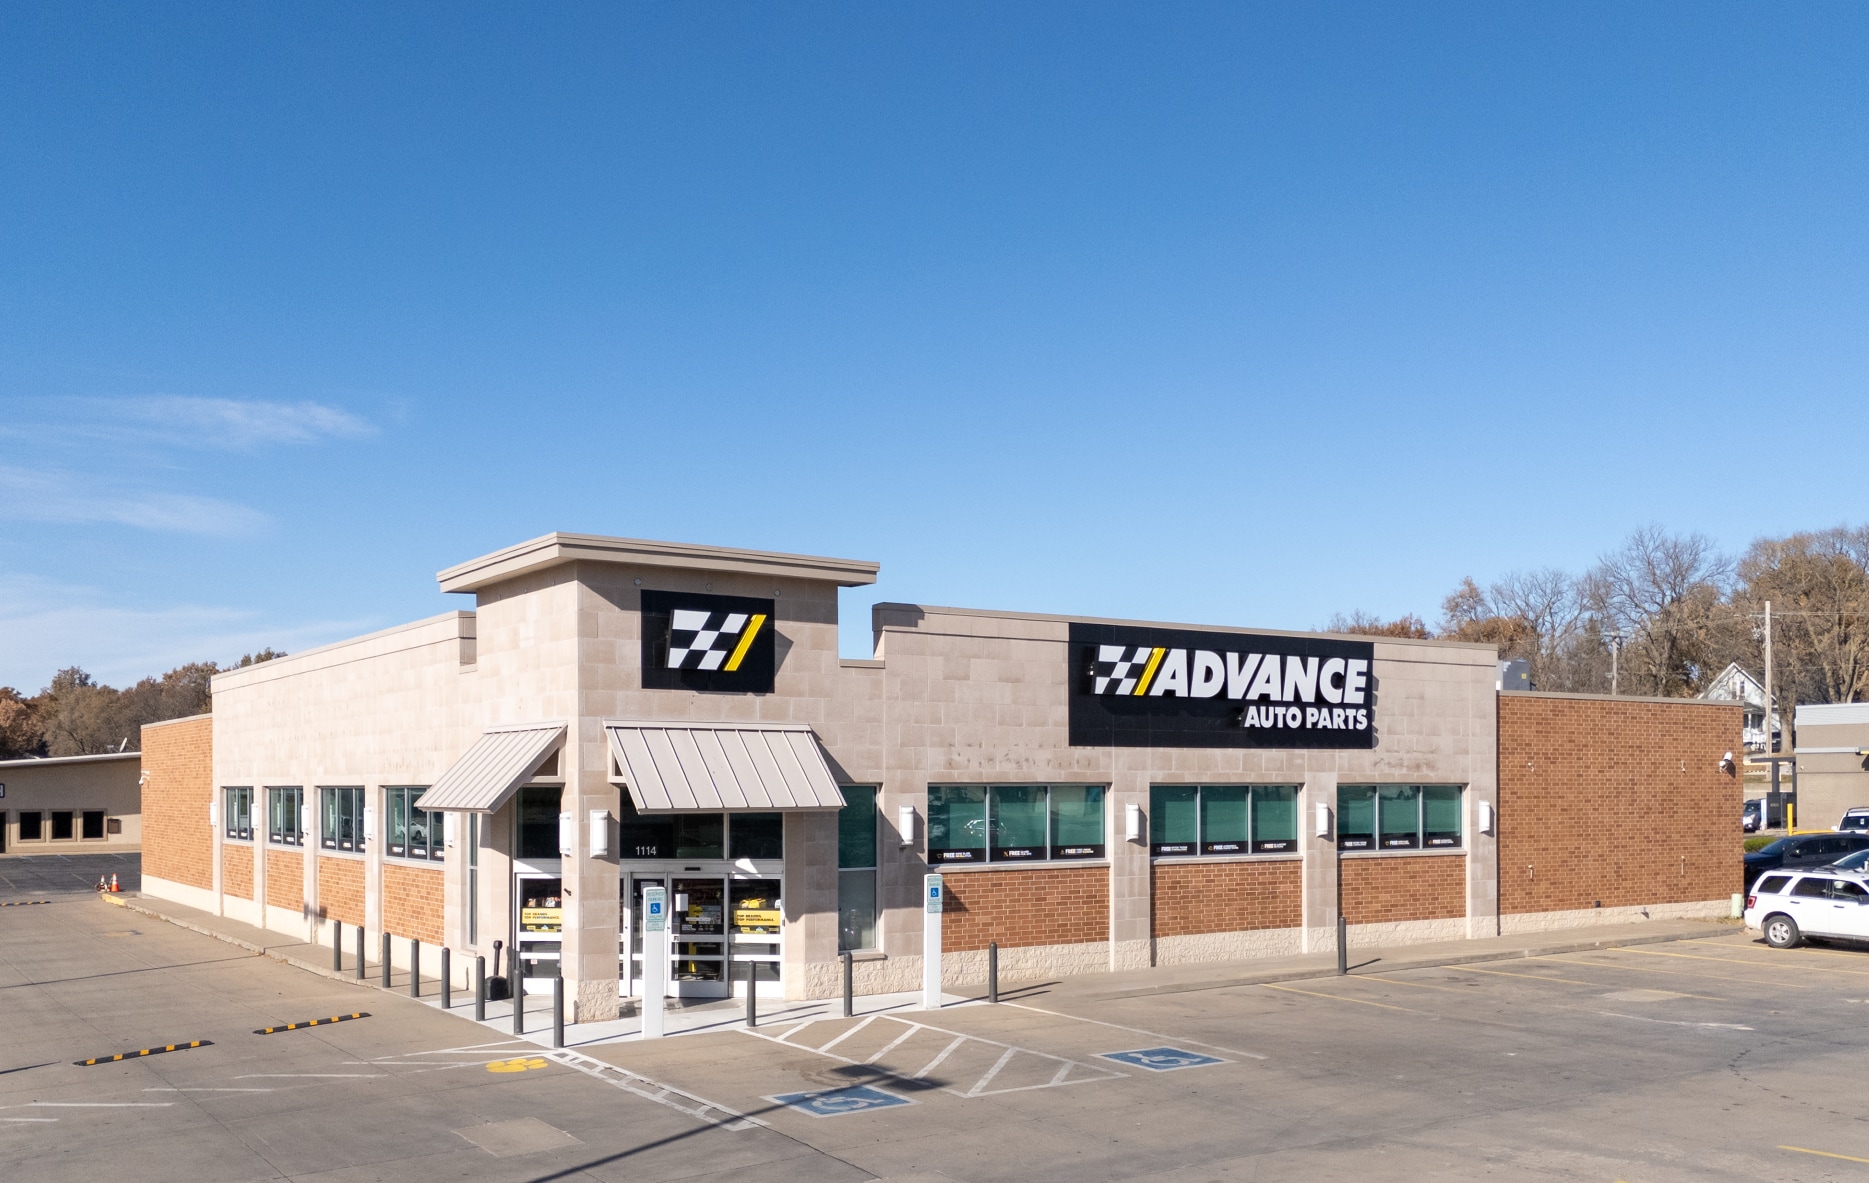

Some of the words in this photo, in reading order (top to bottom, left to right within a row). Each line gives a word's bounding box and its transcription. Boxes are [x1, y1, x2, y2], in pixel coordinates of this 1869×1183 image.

[1148, 648, 1368, 704] ADVANCE
[1244, 705, 1303, 729] AUTO
[1306, 708, 1368, 731] PARTS
[635, 846, 657, 856] 1114
